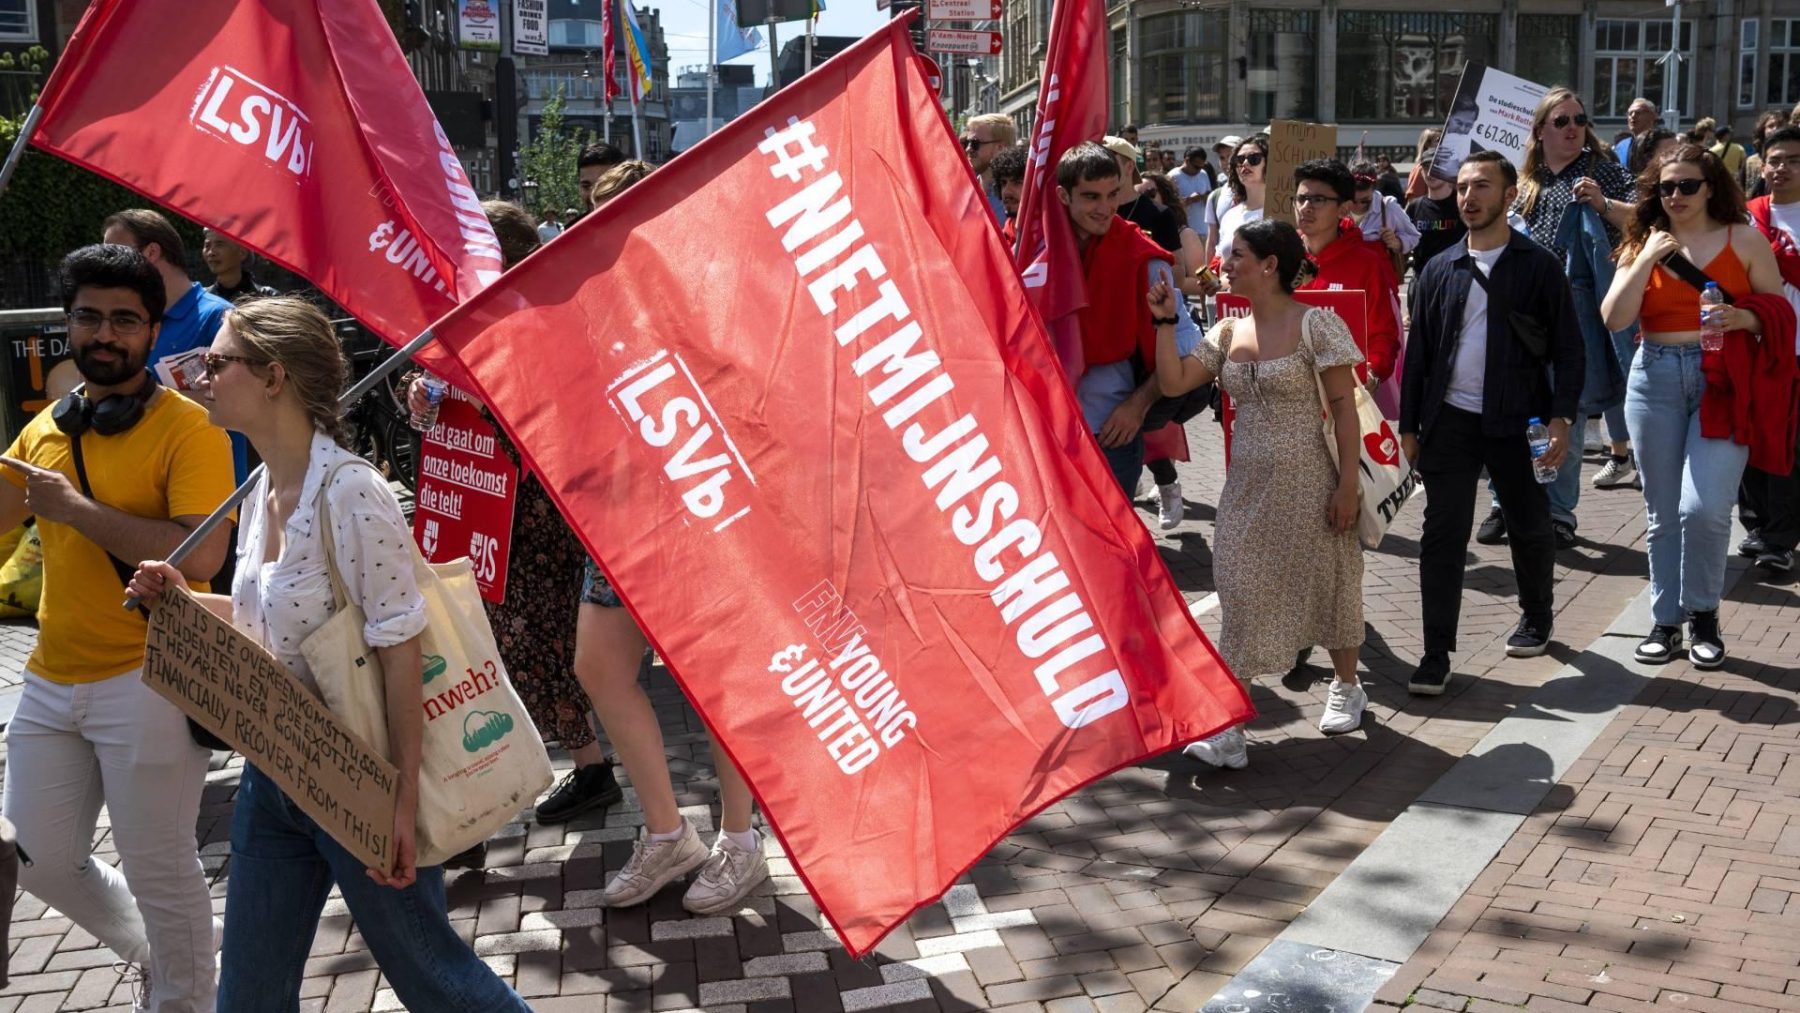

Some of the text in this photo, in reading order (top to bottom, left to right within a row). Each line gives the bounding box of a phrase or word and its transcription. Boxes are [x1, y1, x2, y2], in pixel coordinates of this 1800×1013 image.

[517, 0, 544, 11] FASHION
[519, 10, 542, 19] DRINKS
[522, 19, 539, 31] FOOD
[1488, 95, 1498, 103] De
[1497, 109, 1515, 120] Mark
[199, 75, 306, 175] LSVb
[11, 339, 46, 358] THE
[447, 425, 474, 450] gaat
[475, 433, 495, 455] om
[616, 361, 733, 519] LSVb
[758, 115, 1129, 730] #NIETMIJNSCHULD
[420, 483, 463, 516] die telt!
[423, 454, 508, 495] onze toekomst
[155, 608, 240, 679] STUDENTEN
[249, 675, 269, 699] EN
[279, 698, 301, 730] JOE
[423, 660, 500, 721] nweh?
[153, 627, 321, 770] THEY ARE NEVER GONNA
[193, 609, 208, 633] IS
[216, 626, 236, 655] DE
[240, 646, 340, 743] OVEREENKOMST
[341, 735, 392, 795] TUSSEN
[768, 643, 880, 775] &UNITED
[235, 710, 293, 782] RECOVER
[297, 766, 338, 819] FROM
